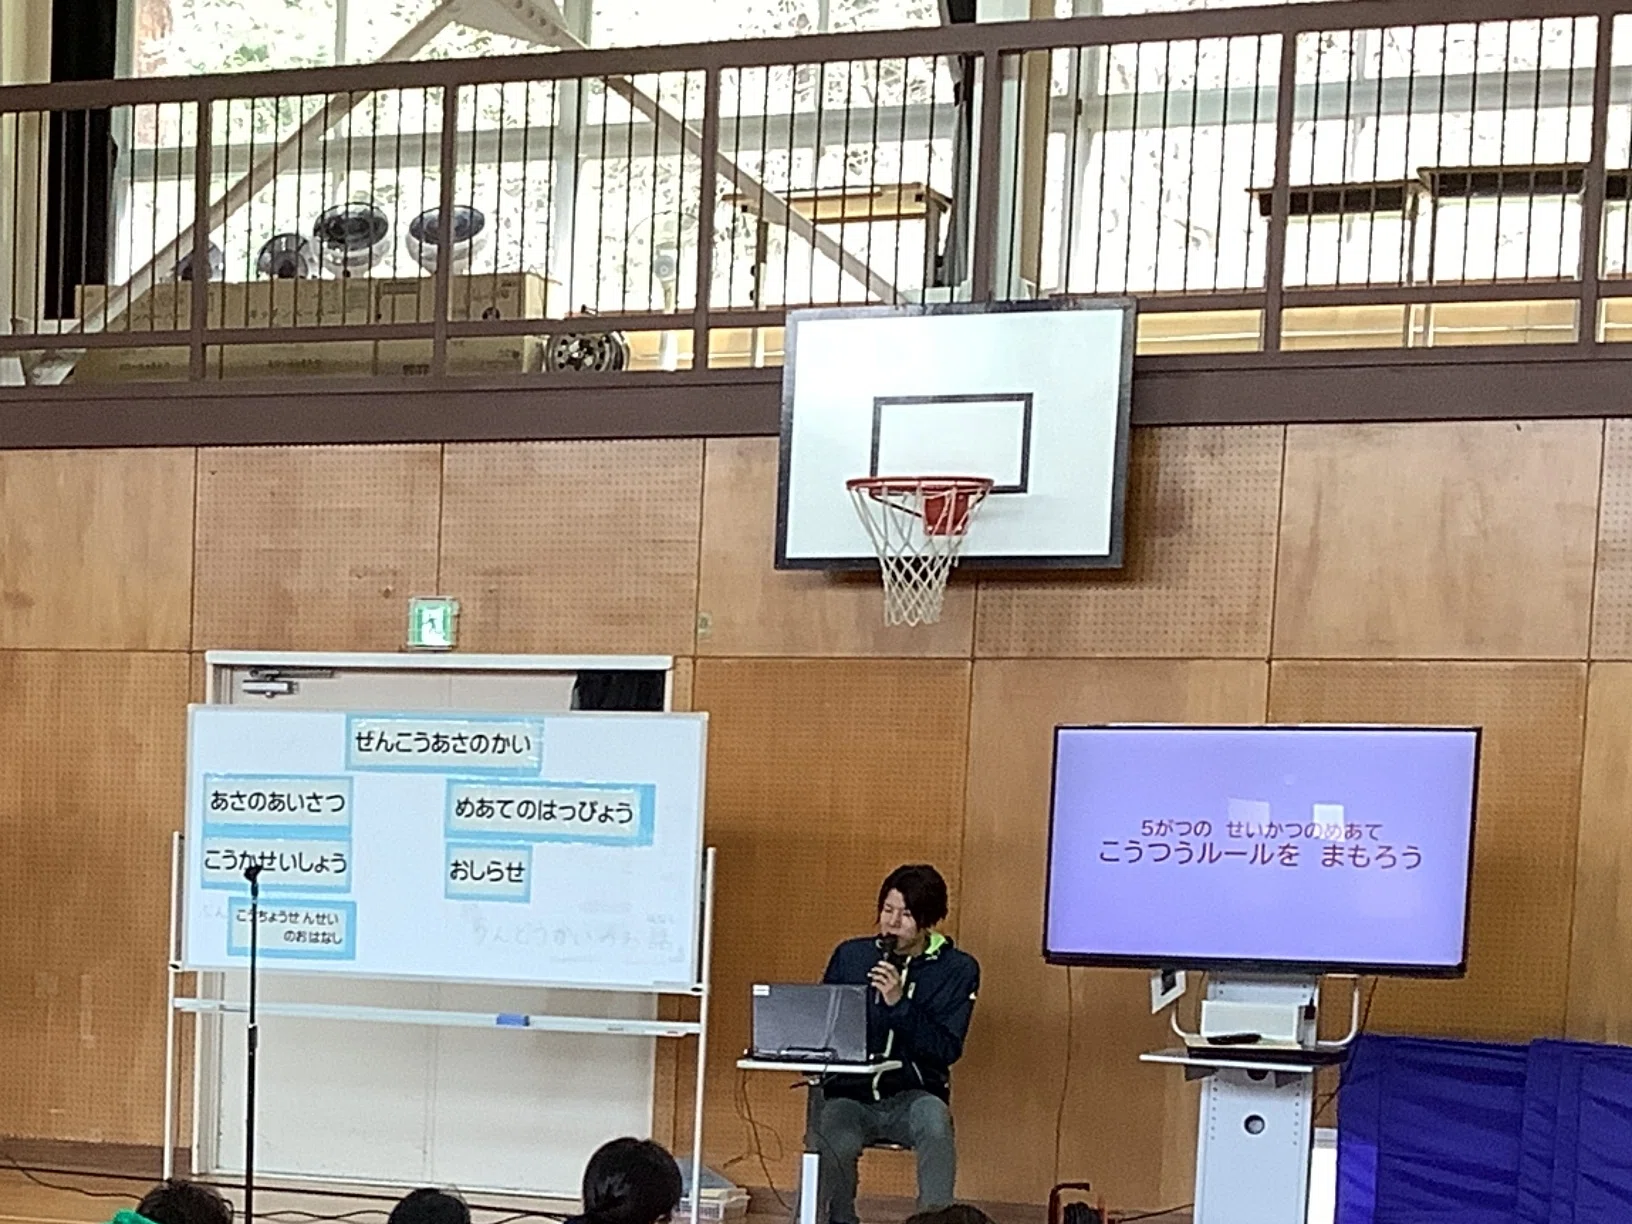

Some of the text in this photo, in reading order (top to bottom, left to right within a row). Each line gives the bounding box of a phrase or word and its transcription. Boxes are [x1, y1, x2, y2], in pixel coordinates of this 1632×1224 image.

[356, 731, 531, 754] ぜんこうあさのかい
[210, 790, 345, 812] あさのあいさつ
[455, 797, 633, 823] めあてのはっぴょう
[1141, 819, 1383, 840] 5がつの せいかつのめあて
[205, 850, 347, 874] こうかせいしょう
[1099, 840, 1422, 869] こうつうルールを まもろう
[450, 860, 525, 883] おしらせ
[284, 930, 343, 945] のおはなし
